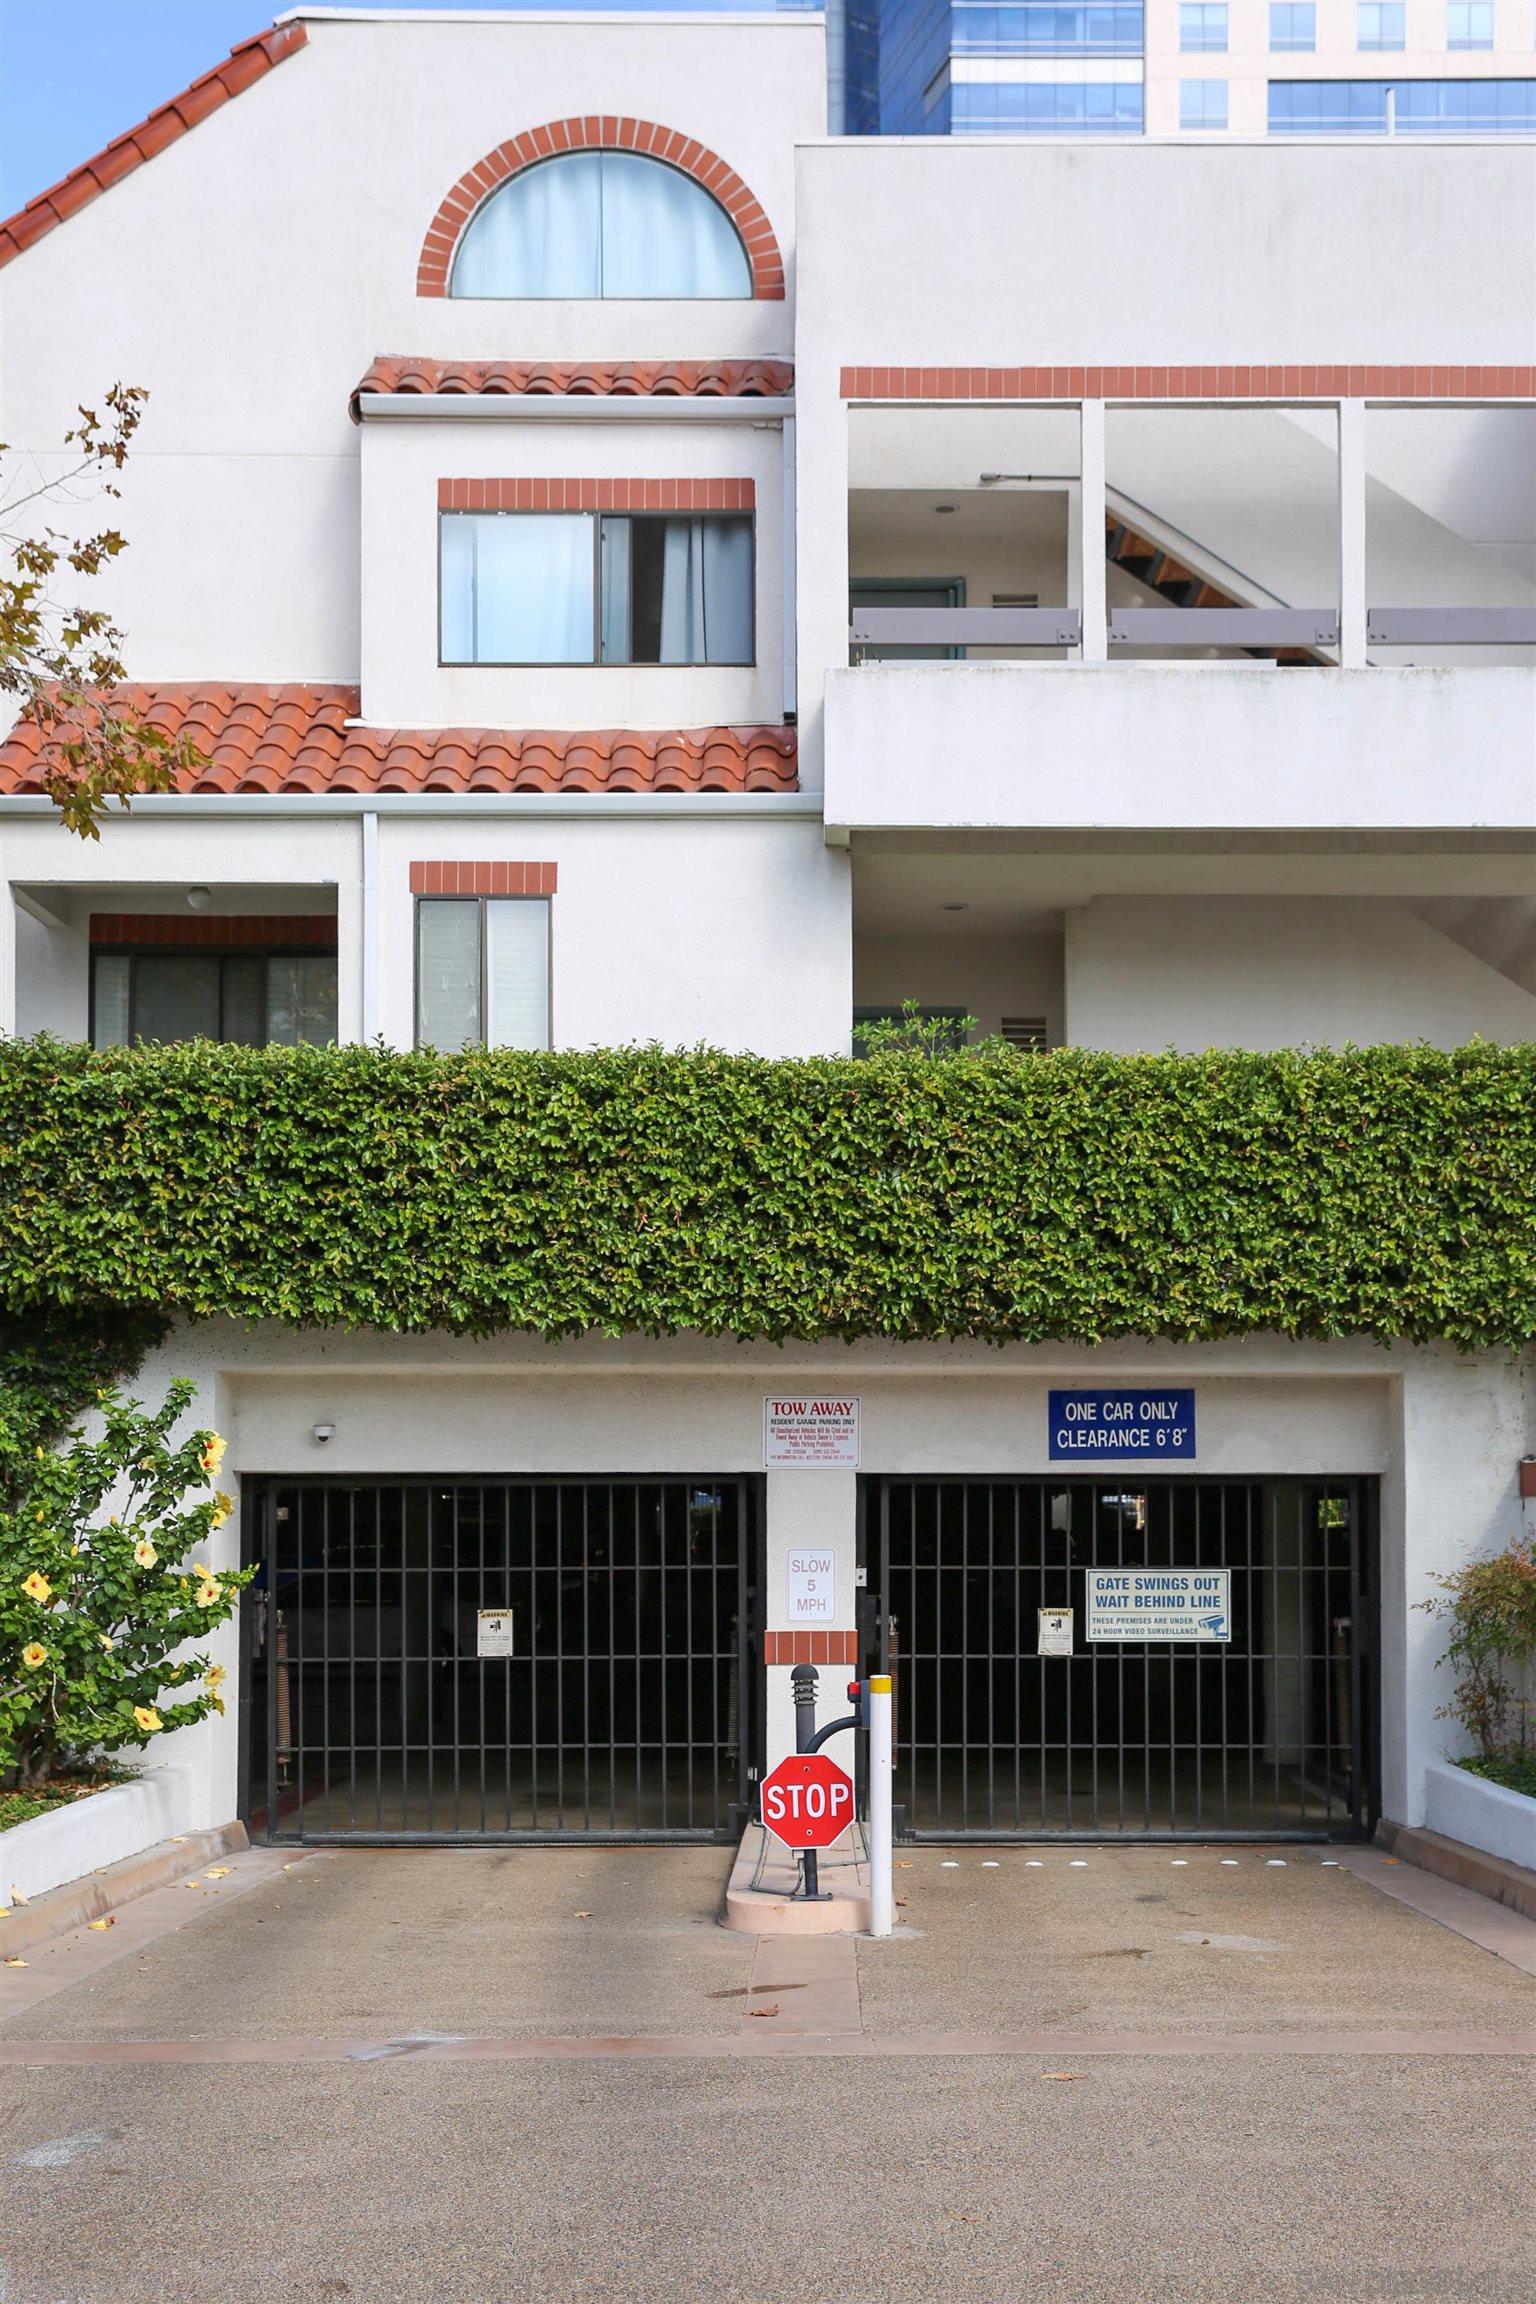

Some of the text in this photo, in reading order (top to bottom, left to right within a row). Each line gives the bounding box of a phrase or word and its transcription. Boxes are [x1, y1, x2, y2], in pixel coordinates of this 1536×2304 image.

[772, 1402, 853, 1415] TOW AWAY
[1066, 1402, 1178, 1420] ONE CAR ONLY
[1057, 1429, 1150, 1448] CLEARANCE
[792, 1560, 831, 1572] SLOW
[807, 1580, 816, 1592] 5
[1096, 1578, 1220, 1590] GATE SWINGS OUT
[797, 1599, 826, 1611] MPH
[1096, 1595, 1220, 1607] WAIT BEHIND LINE
[767, 1783, 849, 1820] STOP
